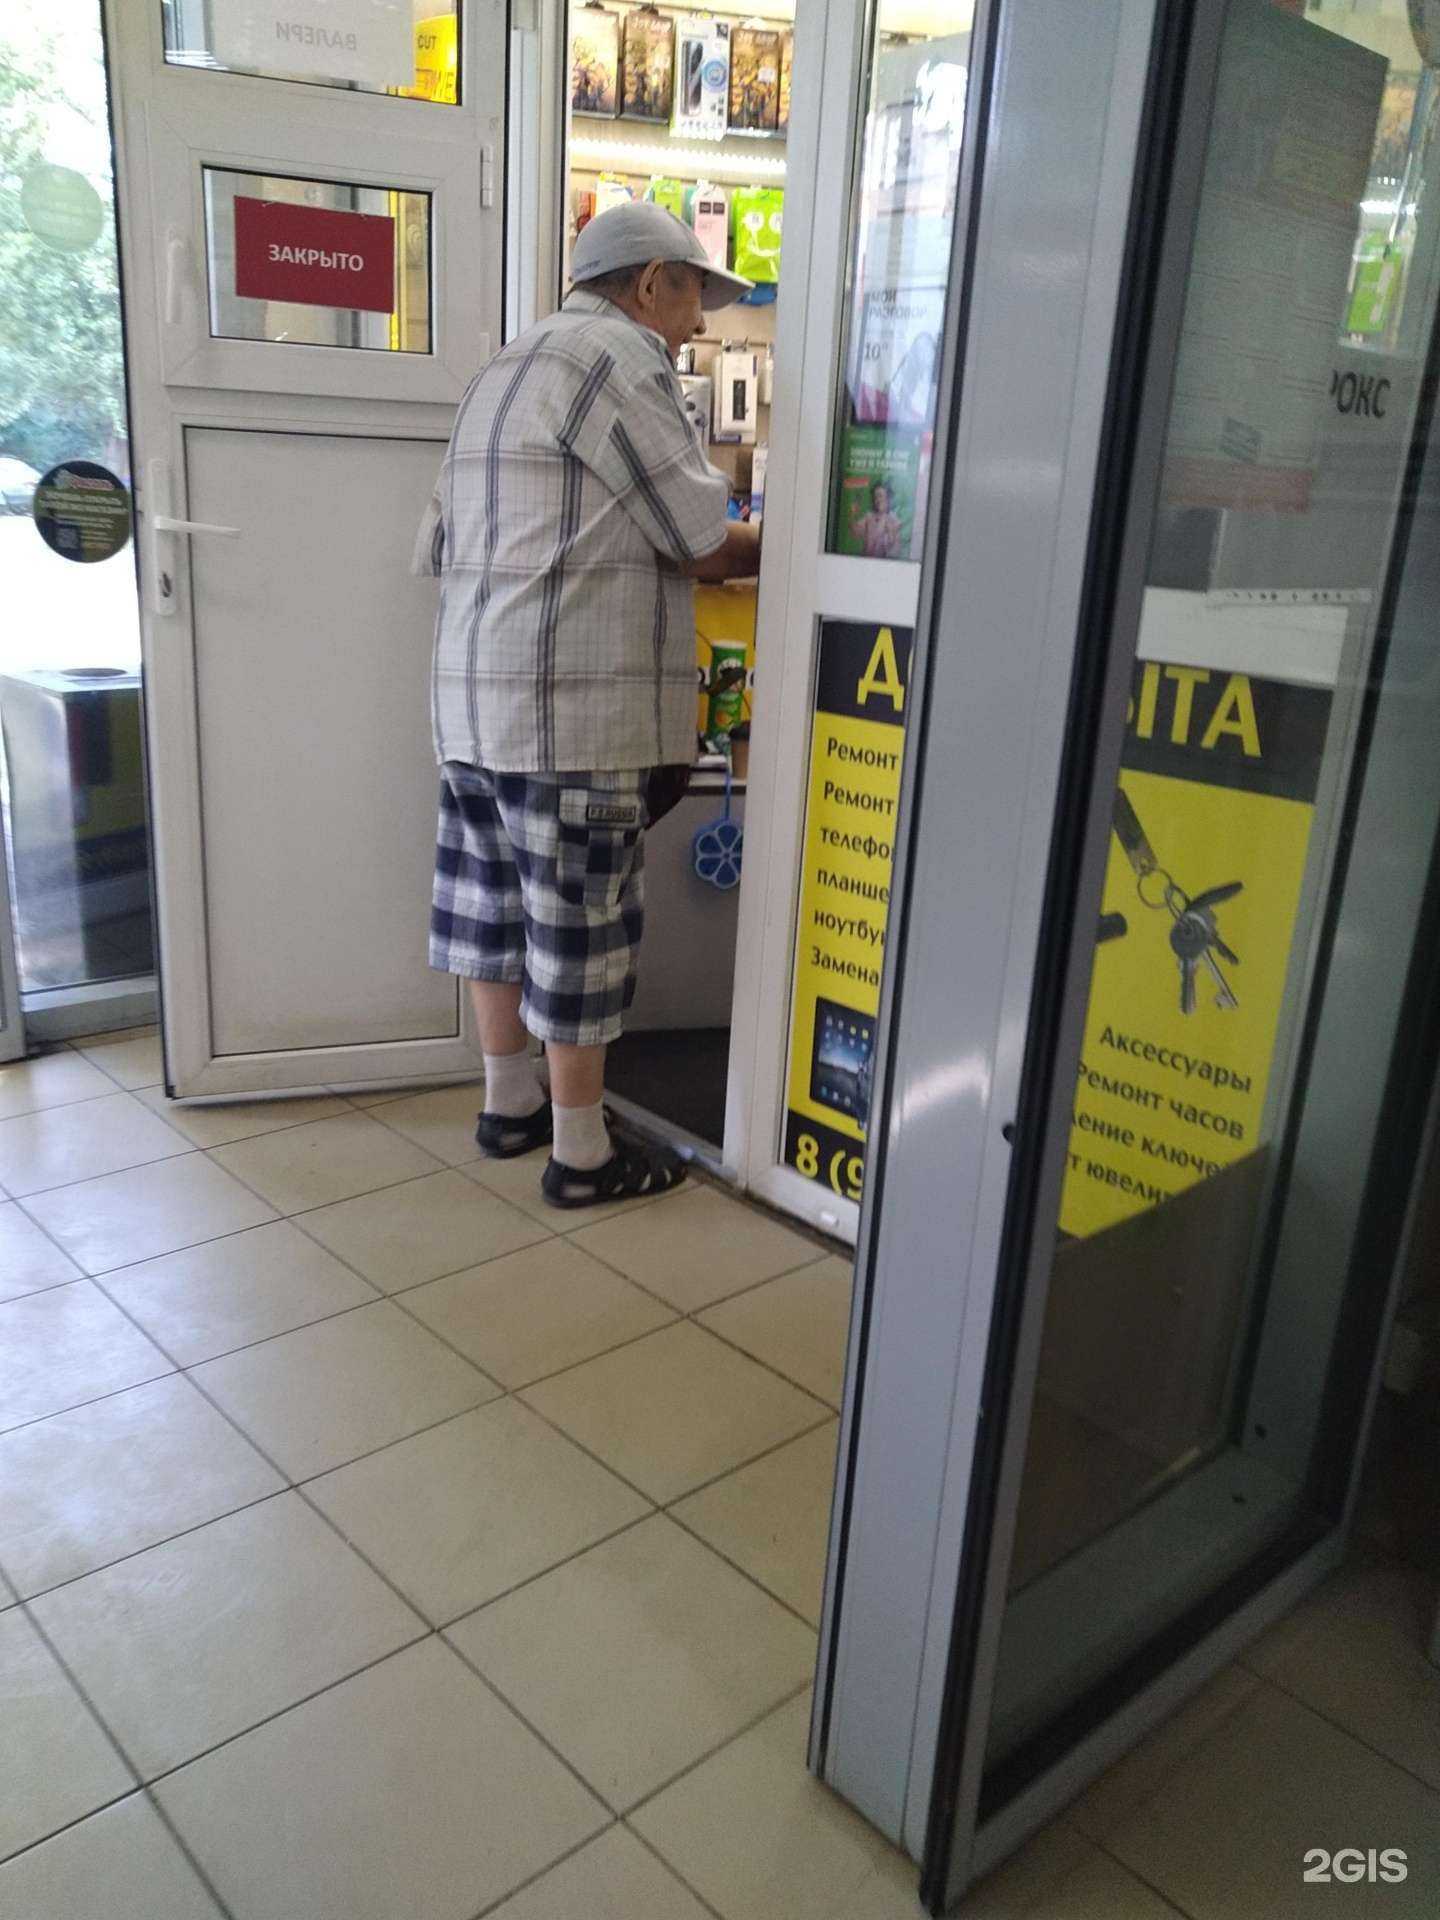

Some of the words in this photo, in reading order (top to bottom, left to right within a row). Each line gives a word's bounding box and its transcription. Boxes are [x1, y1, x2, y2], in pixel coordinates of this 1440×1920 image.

[268, 244, 363, 271] ЗАКРЫТО
[857, 627, 914, 712] Д
[827, 737, 899, 771] Ремонт
[824, 781, 895, 815] Ремонт
[820, 827, 894, 862] телефо
[811, 946, 880, 986] Замена
[1100, 1026, 1252, 1094] Аксессуары
[1169, 1099, 1244, 1141] часов
[796, 1133, 819, 1178] 8
